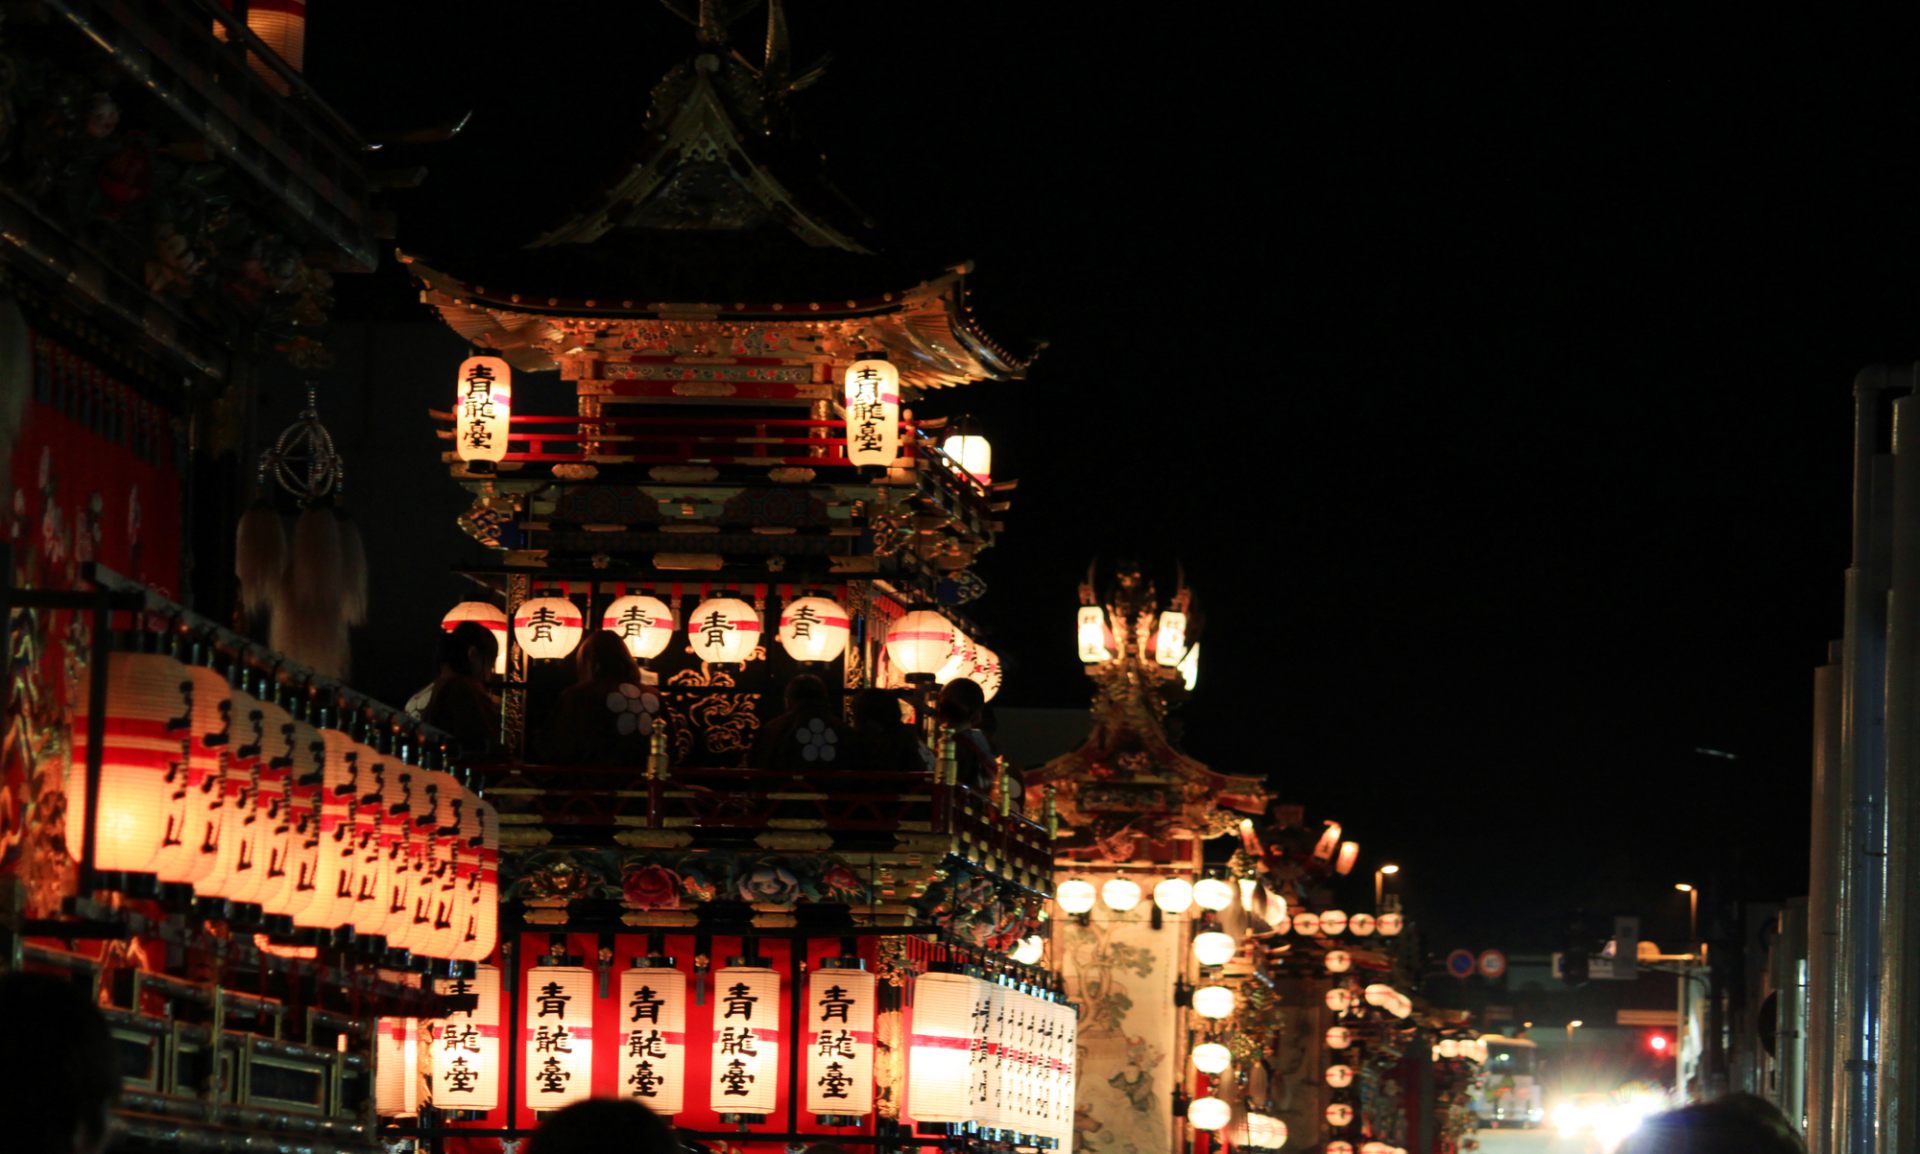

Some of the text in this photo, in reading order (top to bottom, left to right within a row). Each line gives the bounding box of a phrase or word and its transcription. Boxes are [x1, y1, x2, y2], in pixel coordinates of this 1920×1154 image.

[527, 607, 563, 642] 青
[617, 605, 653, 640] 青
[700, 610, 735, 647] 青
[789, 605, 821, 640] 青
